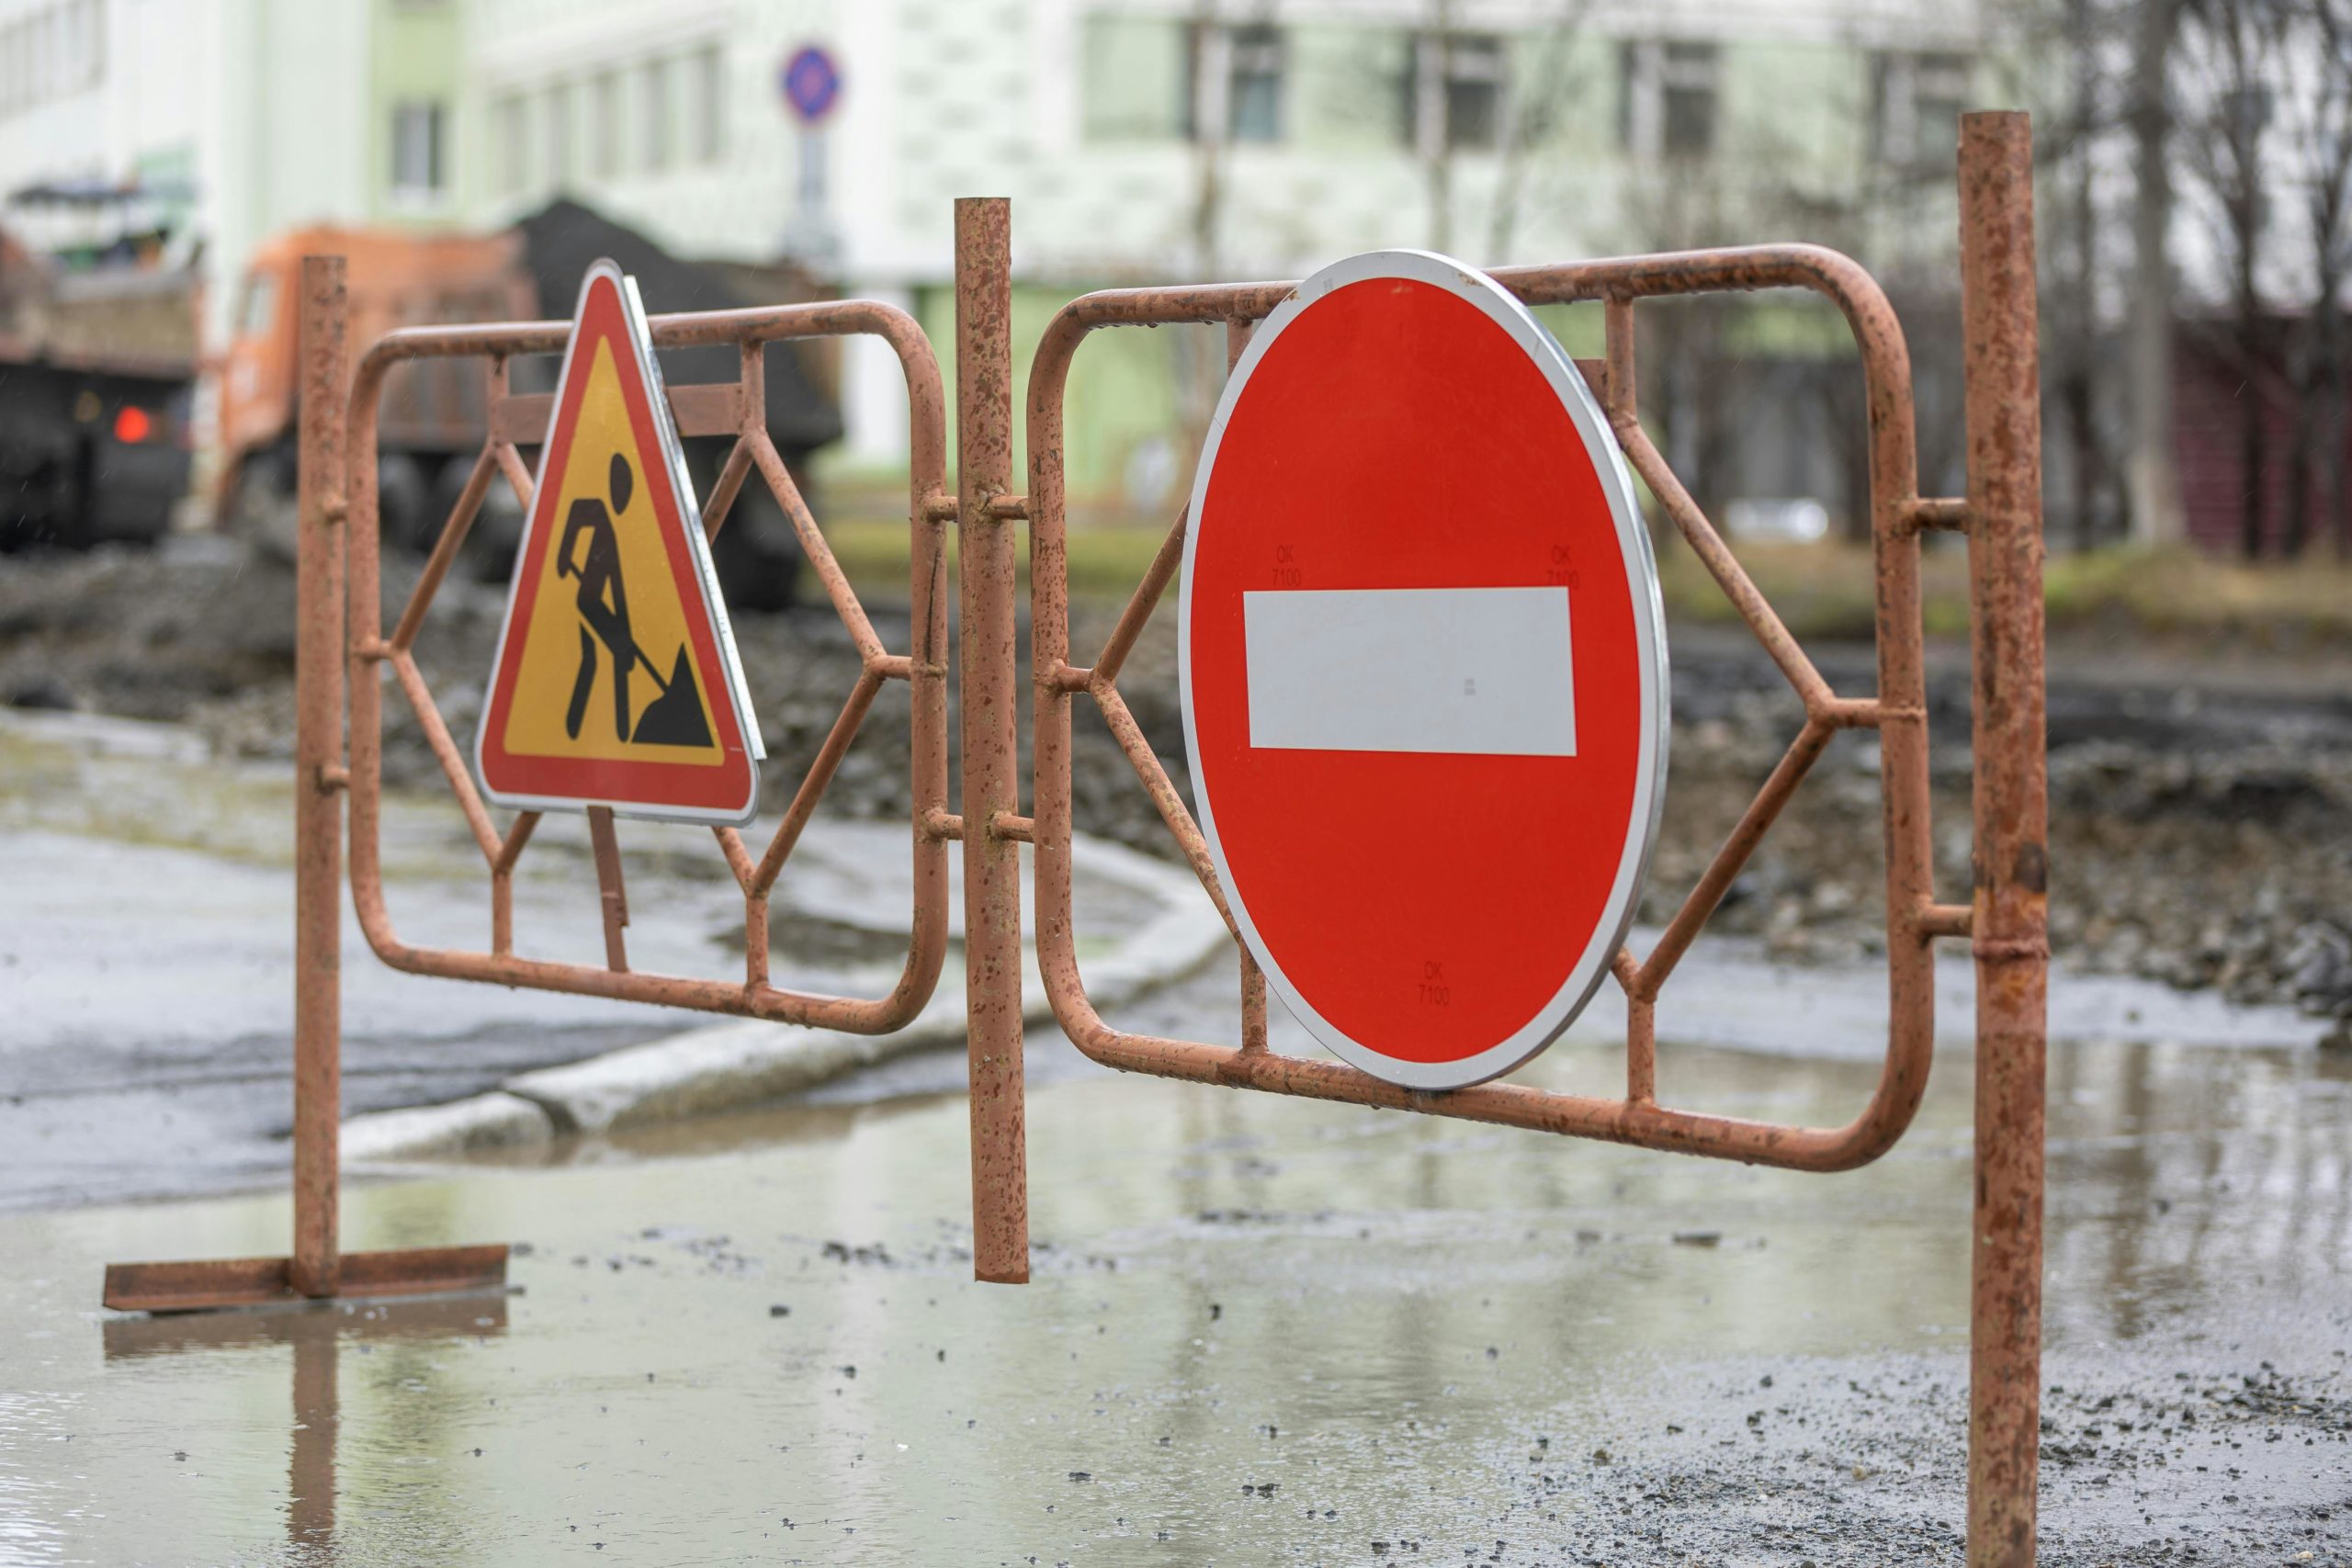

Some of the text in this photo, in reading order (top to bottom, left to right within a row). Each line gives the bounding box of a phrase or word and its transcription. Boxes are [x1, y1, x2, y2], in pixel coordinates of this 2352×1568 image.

[1277, 544, 1294, 564] OK
[1272, 568, 1301, 588] 7100
[1424, 961, 1442, 981] OK
[1419, 985, 1449, 1007] 7100
